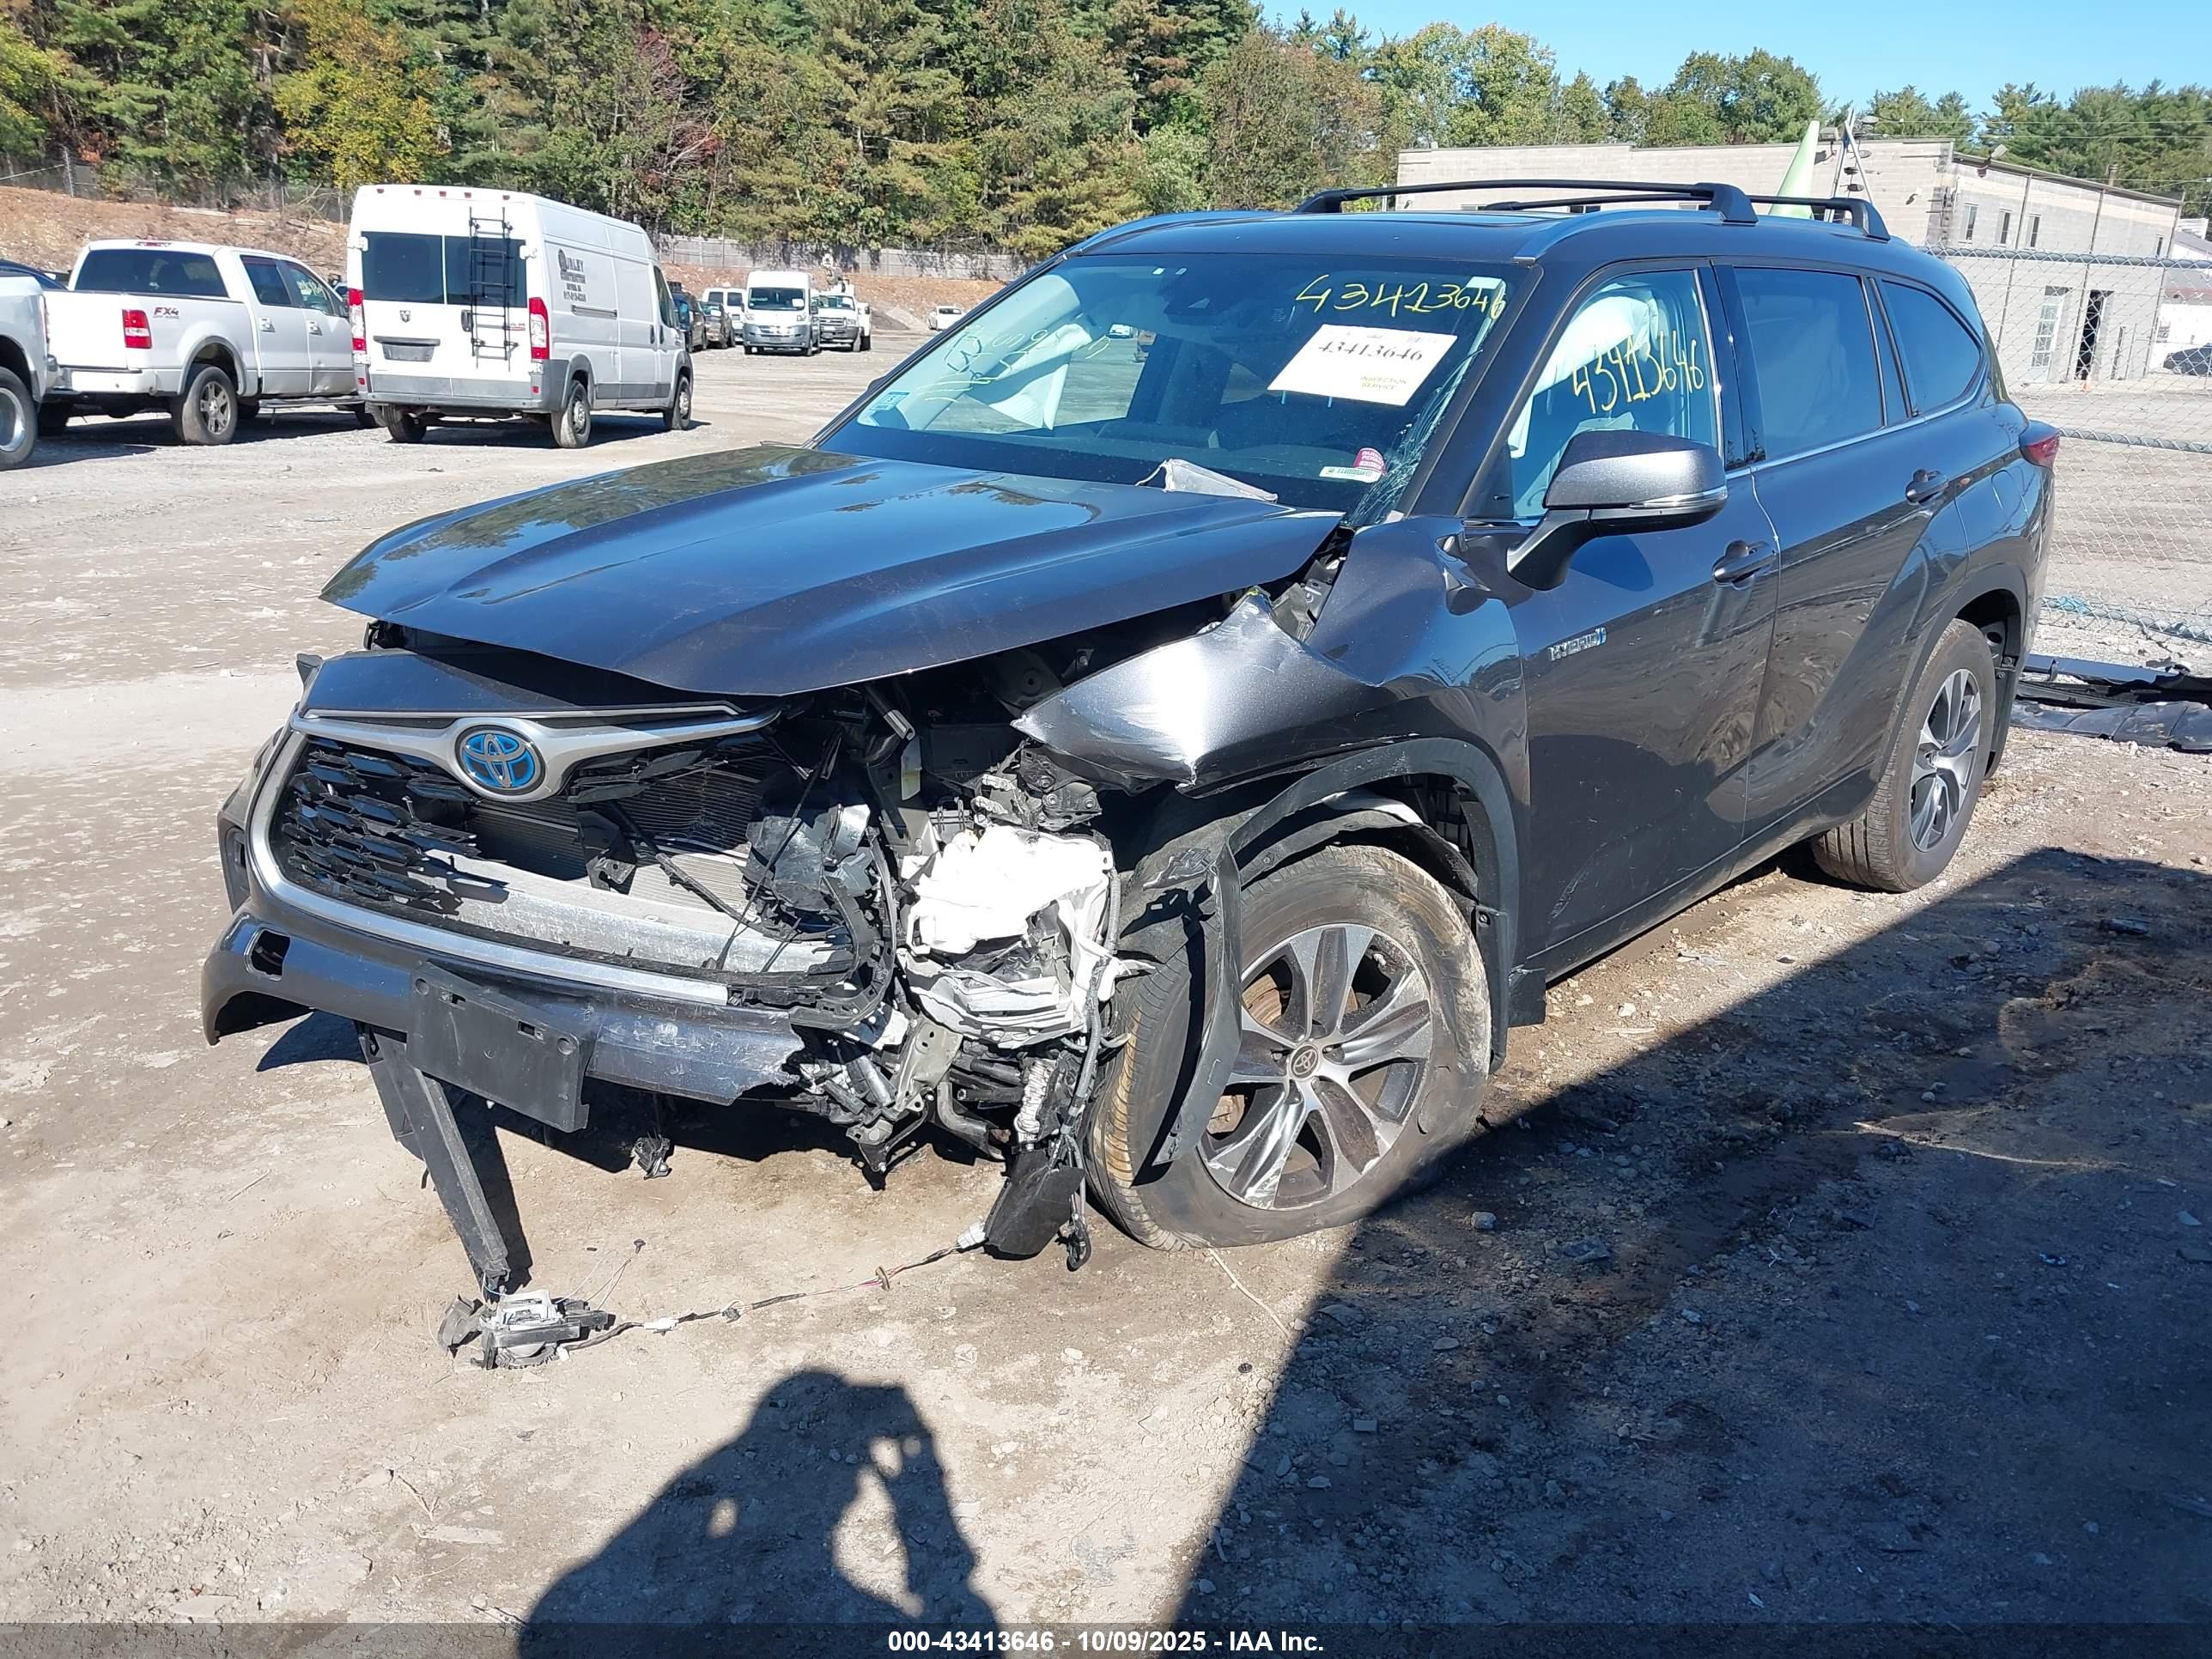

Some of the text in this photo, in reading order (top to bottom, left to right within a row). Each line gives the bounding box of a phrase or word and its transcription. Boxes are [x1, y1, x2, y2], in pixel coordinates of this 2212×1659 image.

[154, 307, 179, 316] FX4
[1296, 274, 1507, 319] 43413646
[1319, 341, 1423, 361] 43413646
[1571, 331, 1705, 414] 43413646
